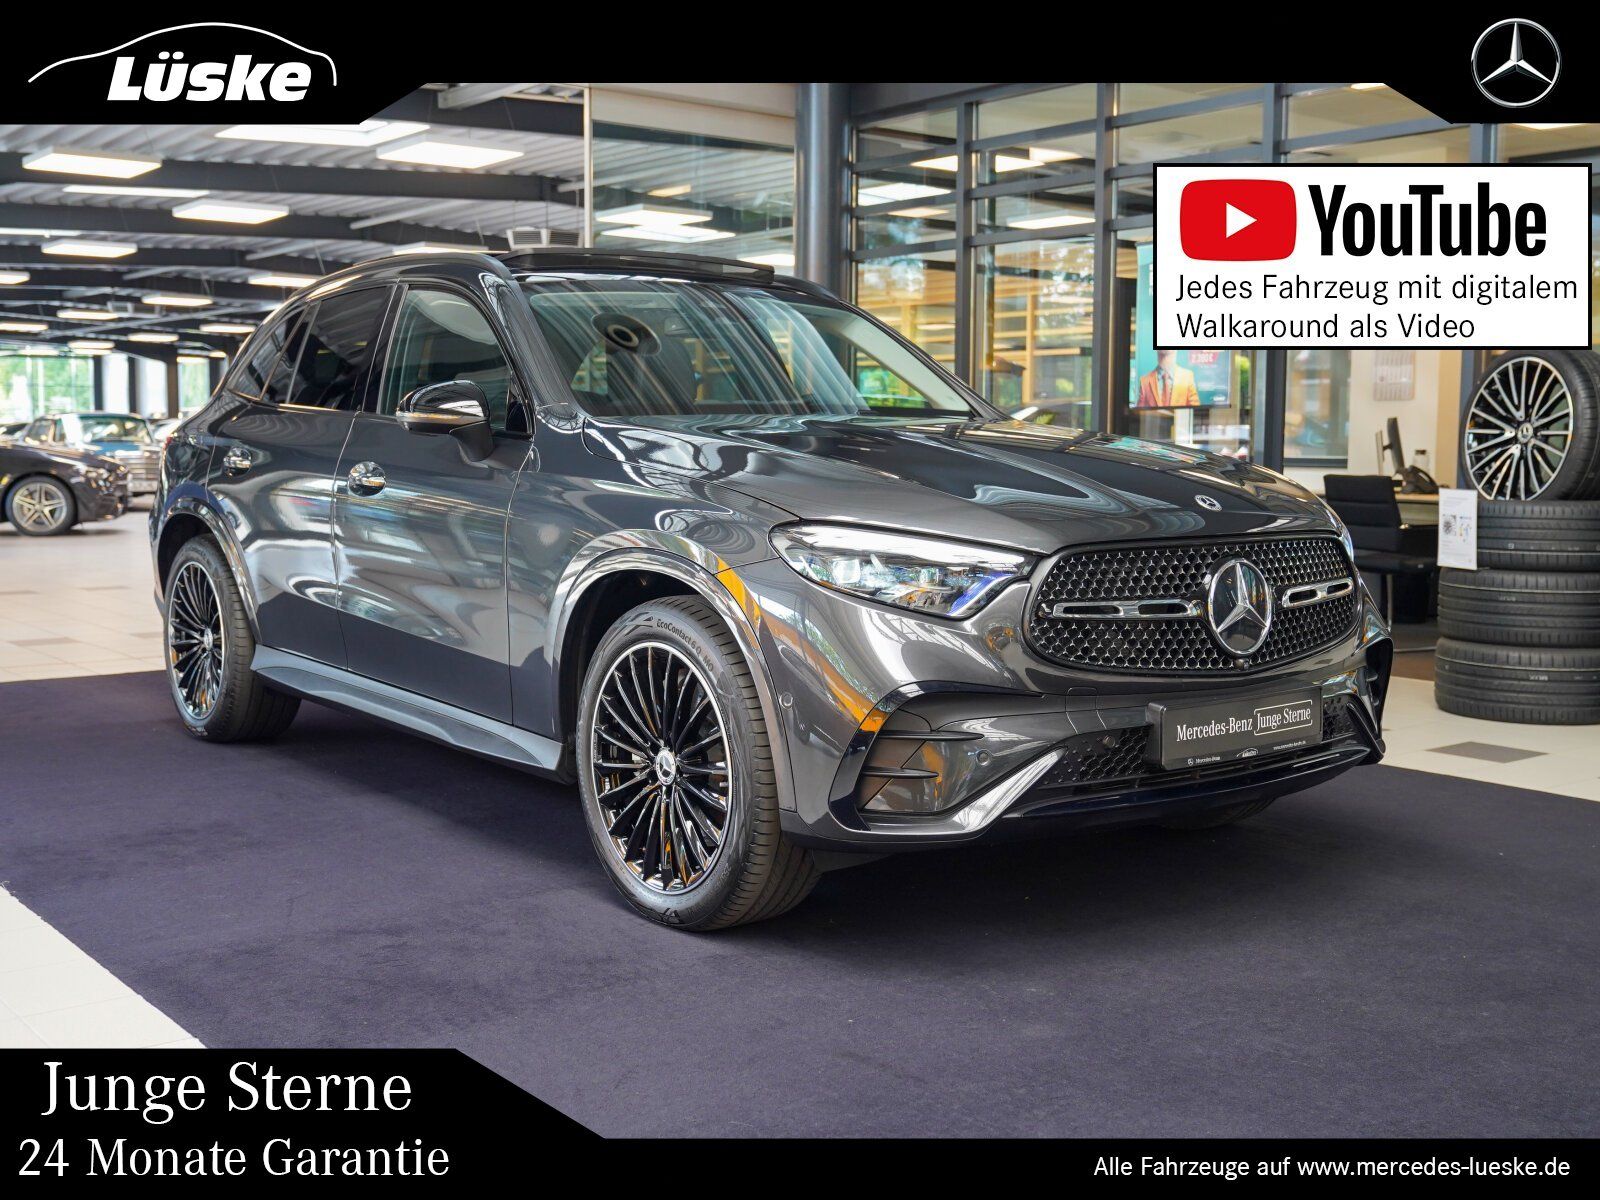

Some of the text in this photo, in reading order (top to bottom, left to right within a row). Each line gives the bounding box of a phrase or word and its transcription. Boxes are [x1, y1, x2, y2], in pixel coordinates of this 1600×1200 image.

[656, 619, 691, 645] EcoContact
[1177, 708, 1311, 742] Mercedes-Benz Junge Sterne
